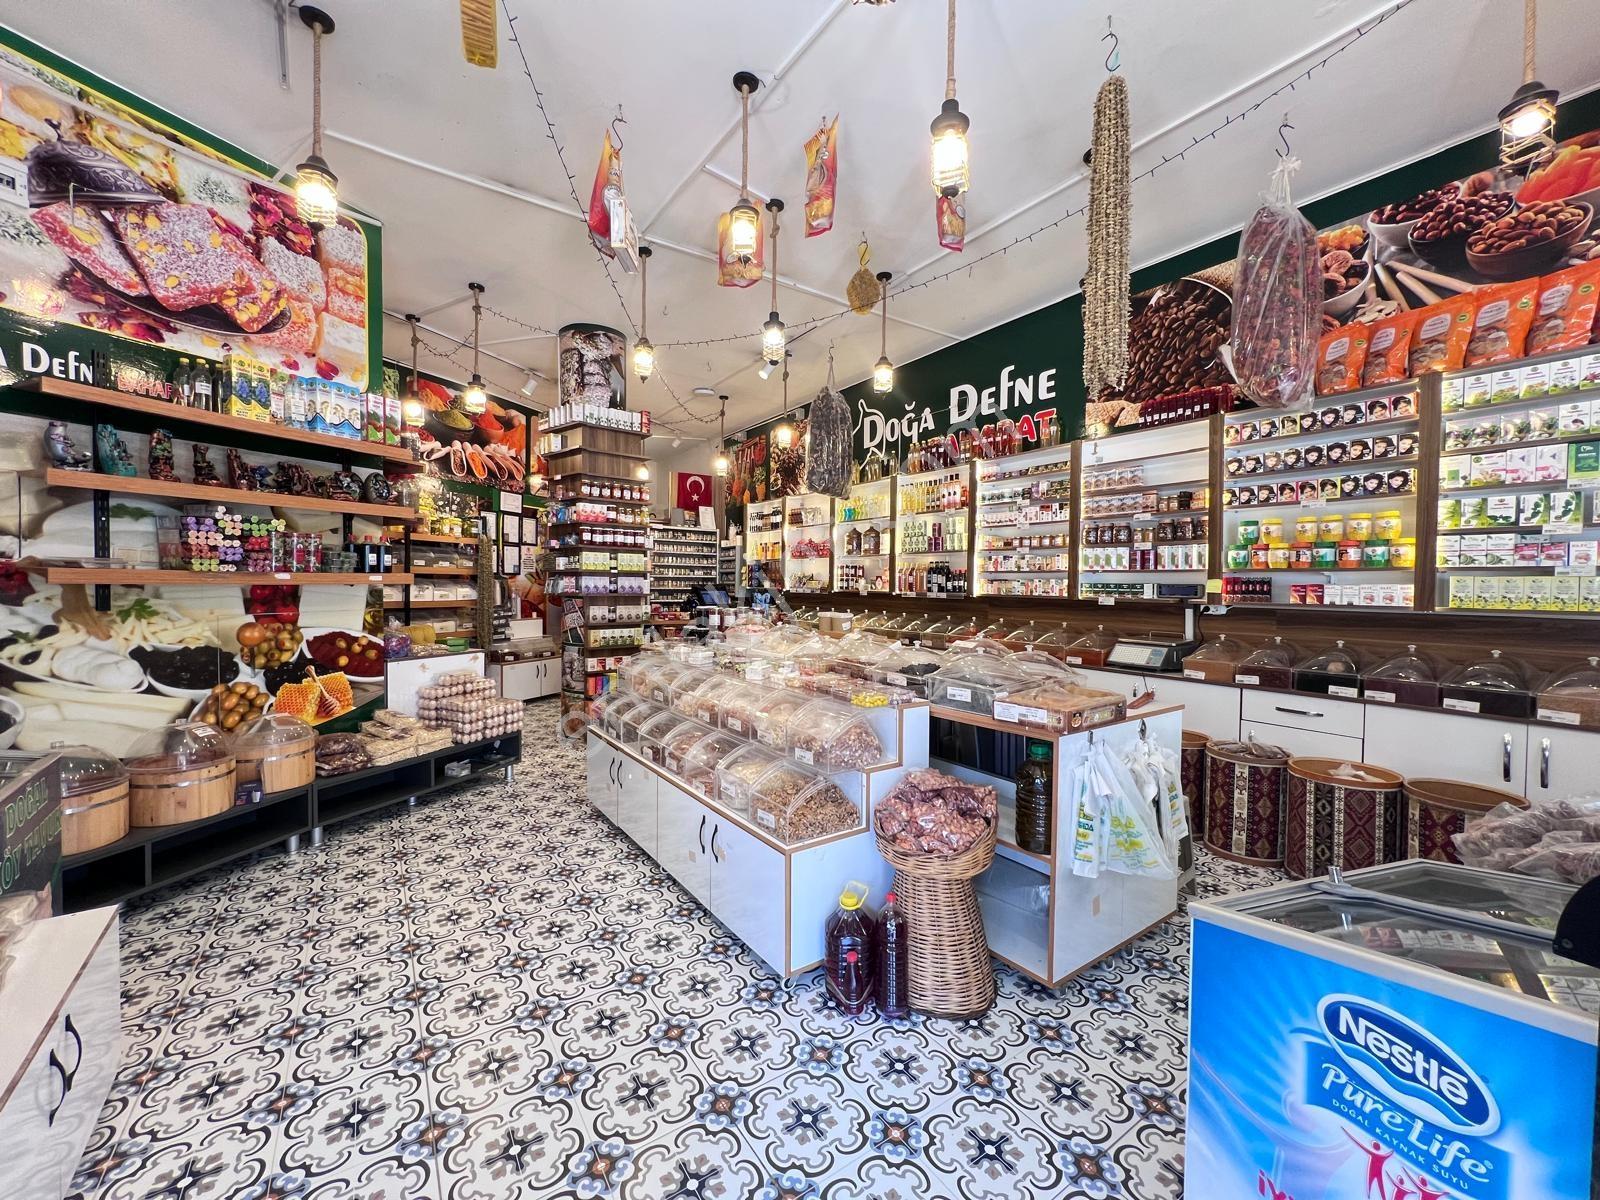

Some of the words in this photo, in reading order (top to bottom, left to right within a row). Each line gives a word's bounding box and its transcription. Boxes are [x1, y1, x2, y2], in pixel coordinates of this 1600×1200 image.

[22, 342, 93, 384] DEFN
[863, 401, 935, 449] DOĞA
[949, 365, 1057, 425] DEFNE
[5, 777, 48, 838] DOĞAL
[0, 845, 22, 895] ÖY
[1339, 1006, 1470, 1106] Nestlé
[1321, 1063, 1405, 1132] Pure
[1375, 1127, 1426, 1164] KAYNAK
[1432, 1164, 1469, 1190] SUYU
